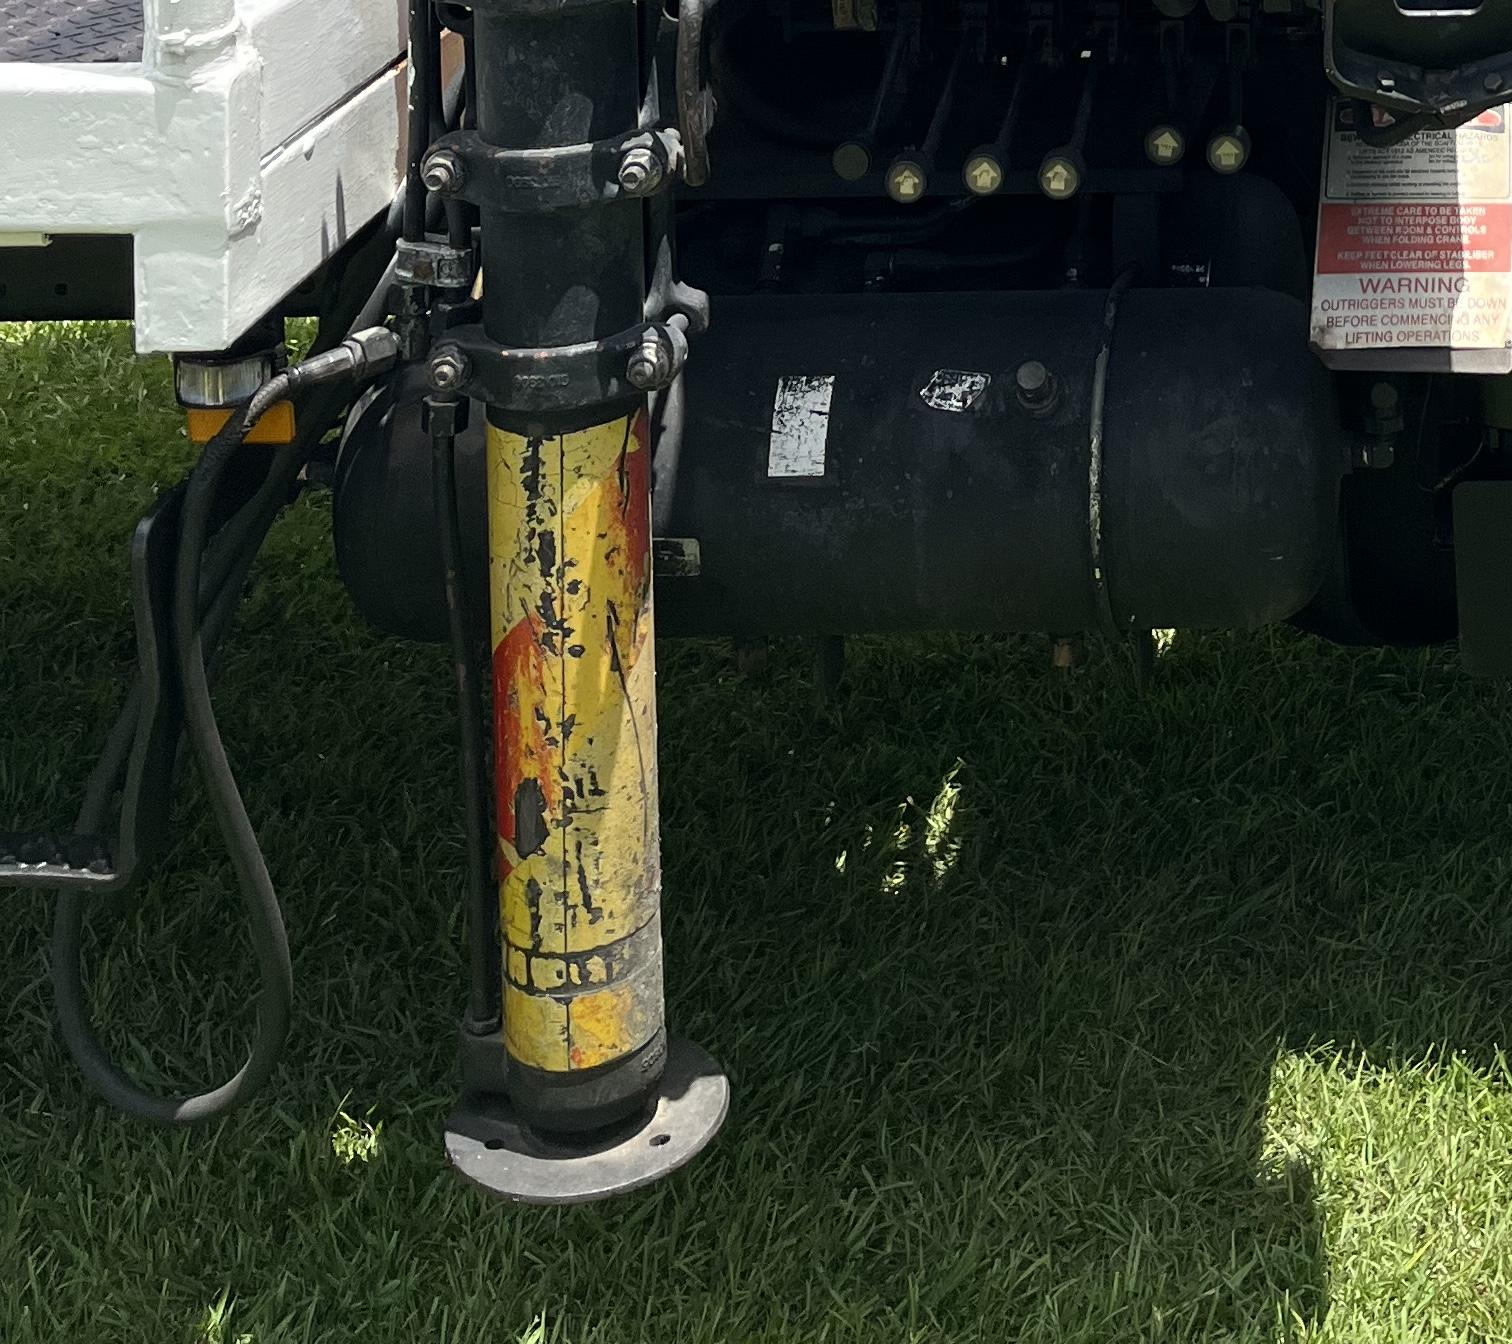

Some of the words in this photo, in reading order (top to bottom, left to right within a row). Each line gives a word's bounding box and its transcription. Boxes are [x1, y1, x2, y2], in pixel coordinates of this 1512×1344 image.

[1396, 206, 1422, 215] CARE
[1424, 206, 1438, 215] TO
[1440, 206, 1452, 215] BE
[1380, 216, 1393, 225] TO
[1393, 235, 1434, 244] FOLDING
[1390, 250, 1423, 259] CLEAR
[1390, 260, 1441, 269] LOWERING
[1359, 277, 1470, 294] WARNING
[1320, 298, 1405, 311] OUTRIGGERS
[1408, 297, 1445, 309] MUST
[1467, 297, 1507, 310] DOWN
[1326, 313, 1378, 328] BEFORE
[1472, 313, 1500, 325] ANY
[1345, 331, 1393, 343] LIFTING
[1396, 329, 1480, 342] OPERATIONS
